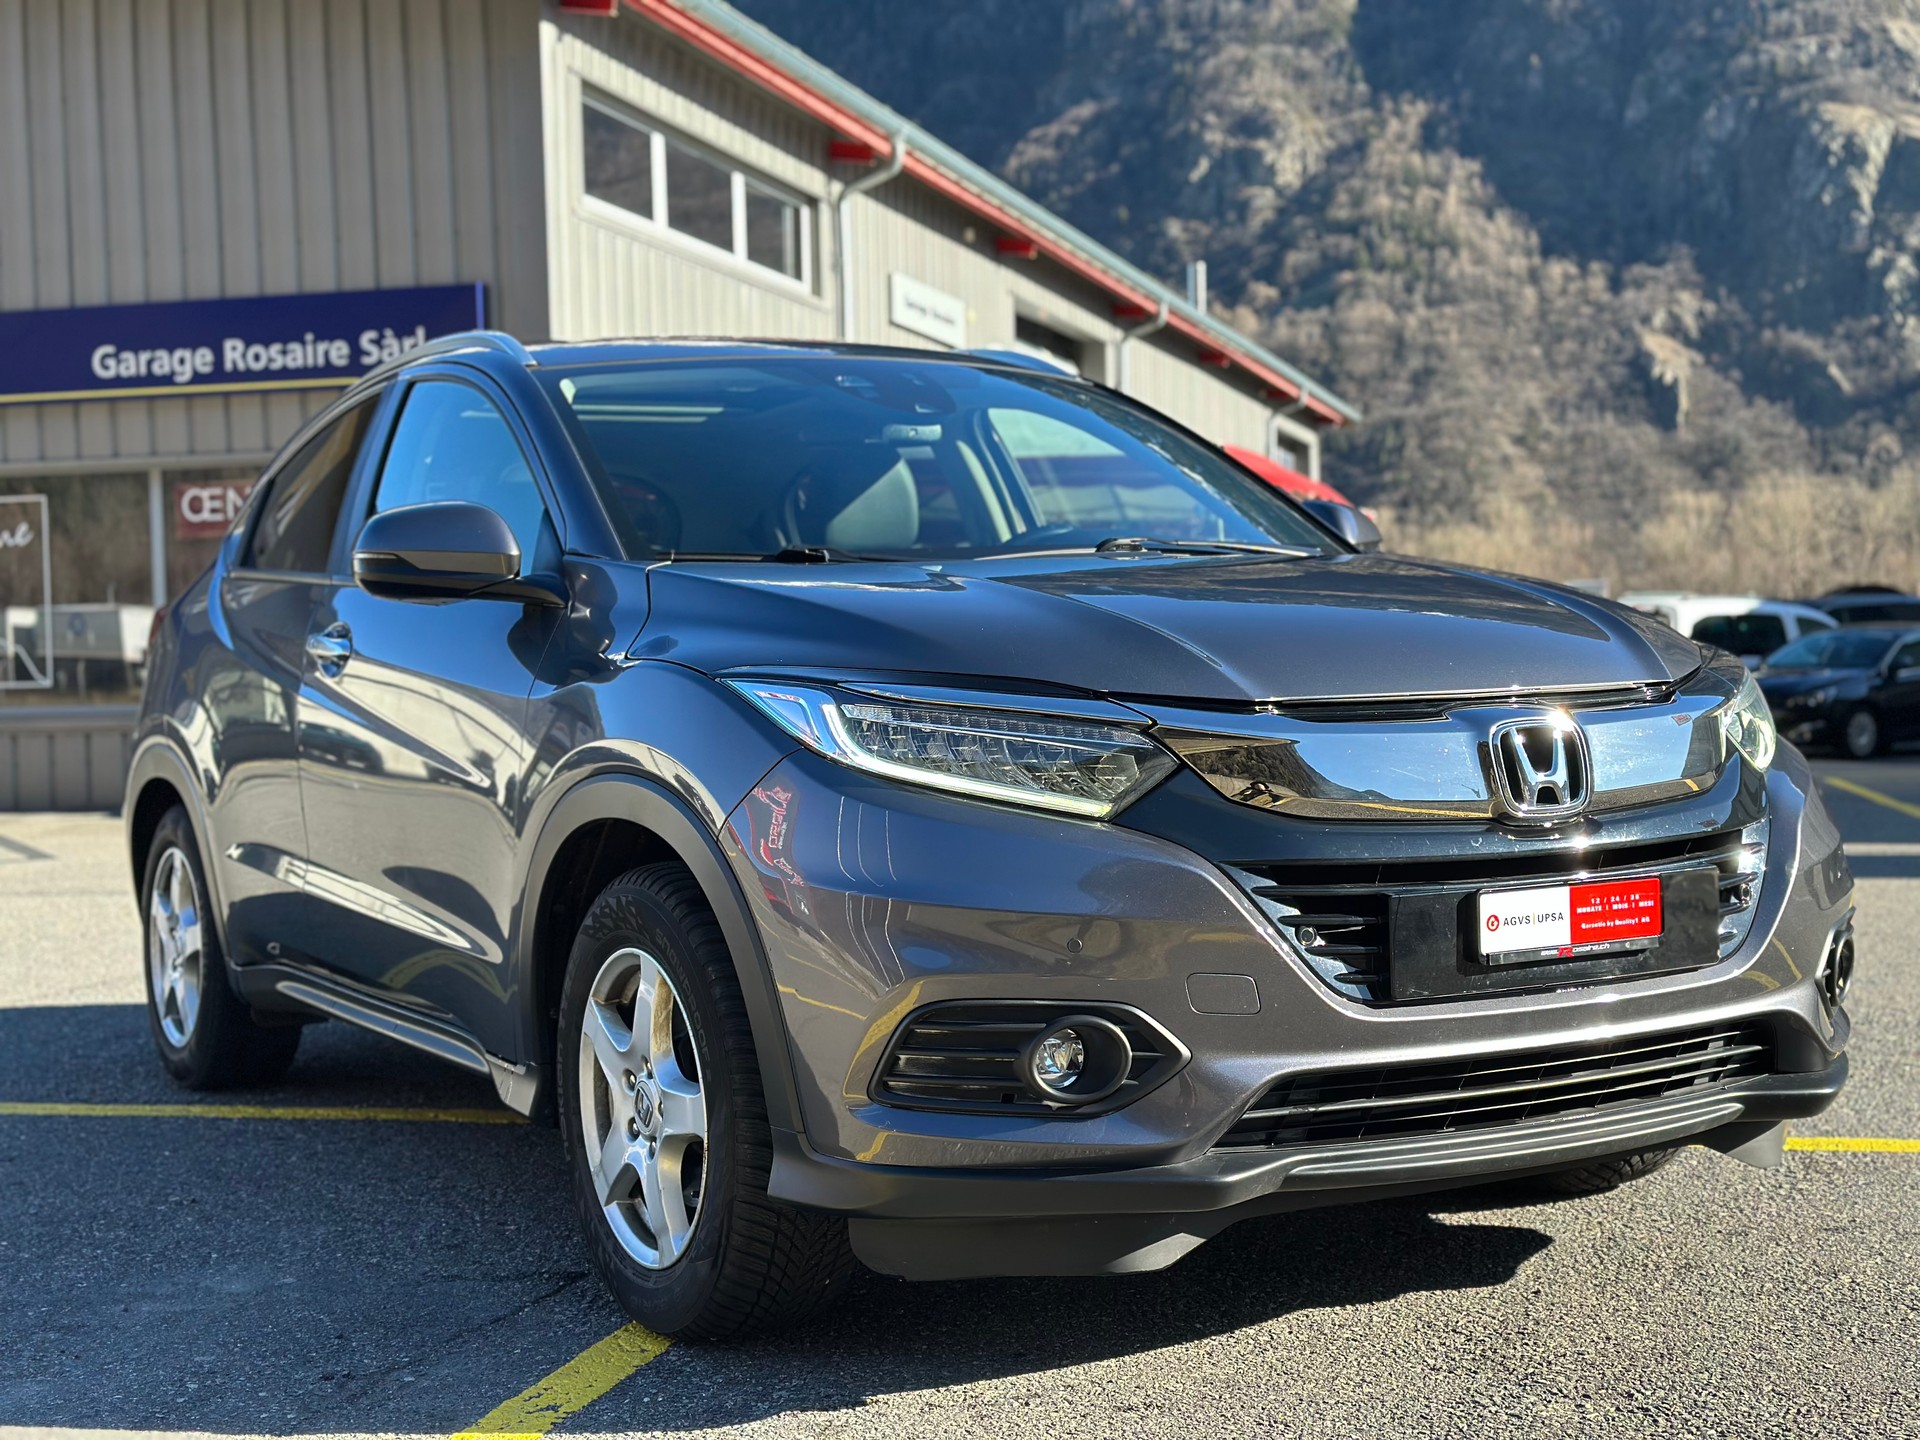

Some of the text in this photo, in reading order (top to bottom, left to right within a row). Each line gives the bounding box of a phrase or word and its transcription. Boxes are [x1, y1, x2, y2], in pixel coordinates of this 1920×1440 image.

[91, 325, 427, 384] Garage Rosaire Sàrl
[1610, 895, 1620, 903] 24
[1612, 902, 1629, 910] MOIS
[1503, 911, 1564, 927] AGVS UPSA
[1606, 920, 1614, 928] by
